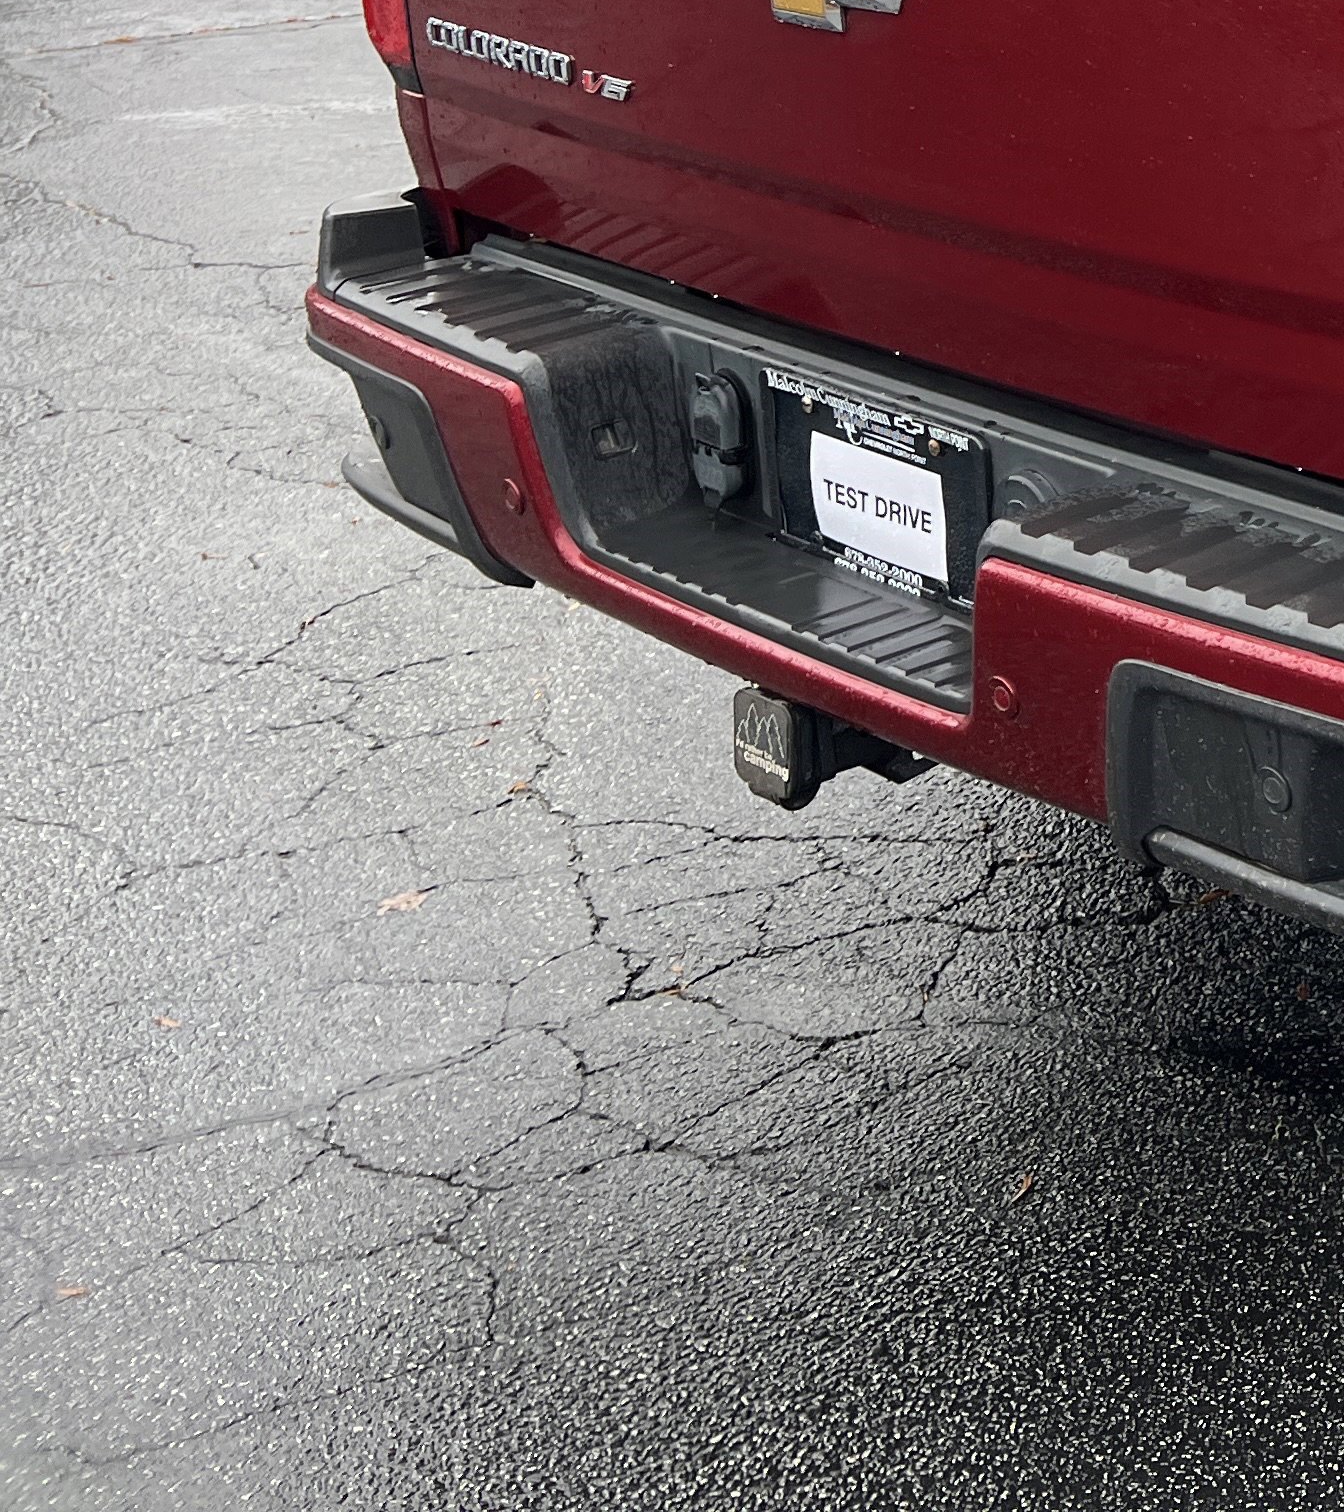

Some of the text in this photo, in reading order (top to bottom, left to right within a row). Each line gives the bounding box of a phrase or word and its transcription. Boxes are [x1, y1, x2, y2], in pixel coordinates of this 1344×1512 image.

[426, 16, 635, 101] COLORADO V6
[766, 368, 819, 401] Malcolm
[817, 386, 891, 427] Cunningham
[823, 478, 932, 534] TEST DRIVE
[744, 751, 789, 782] camping
